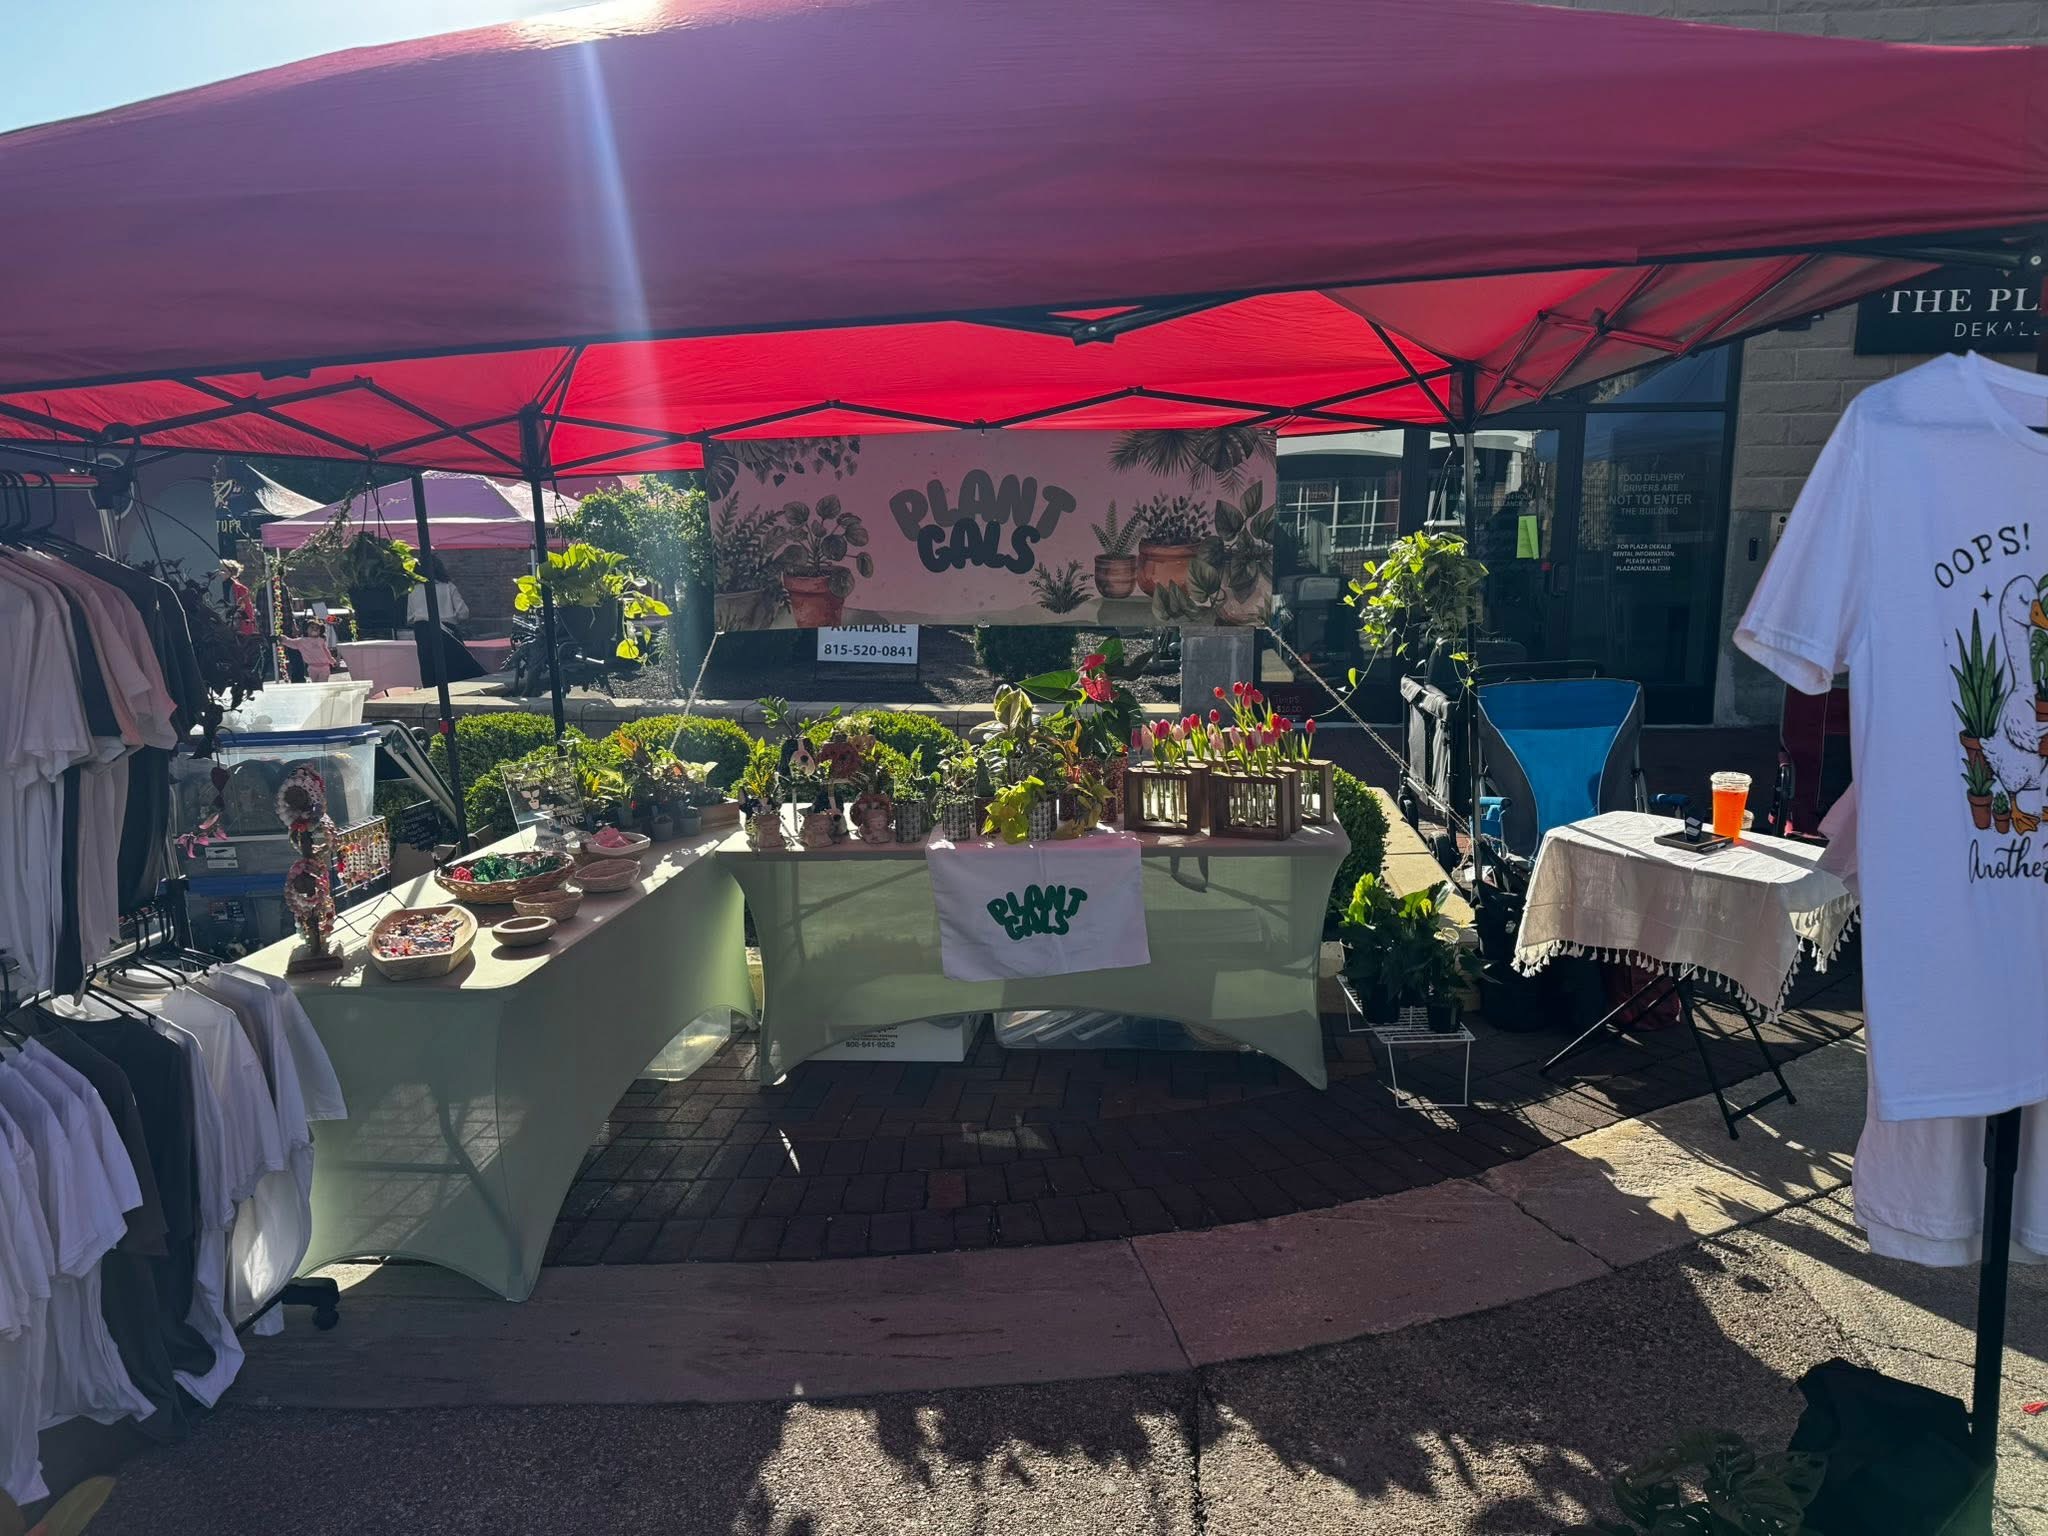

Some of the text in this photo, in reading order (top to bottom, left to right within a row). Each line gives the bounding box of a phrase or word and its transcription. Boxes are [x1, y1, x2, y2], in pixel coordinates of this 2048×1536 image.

[1883, 288, 2042, 313] THE PL
[1619, 473, 1686, 482] FOOD DELIVERY
[1623, 484, 1679, 492] DRIVERS ARE
[889, 469, 1077, 542] PLANT
[1608, 494, 1692, 505] NOT TO ENTER
[1621, 507, 1678, 515] THE BUILDING
[917, 517, 1041, 574] GALS
[1934, 523, 2030, 588] OOPS!
[824, 643, 913, 657] 815-520-0841
[987, 884, 1088, 926] PLANT
[1004, 914, 1069, 941] GALS
